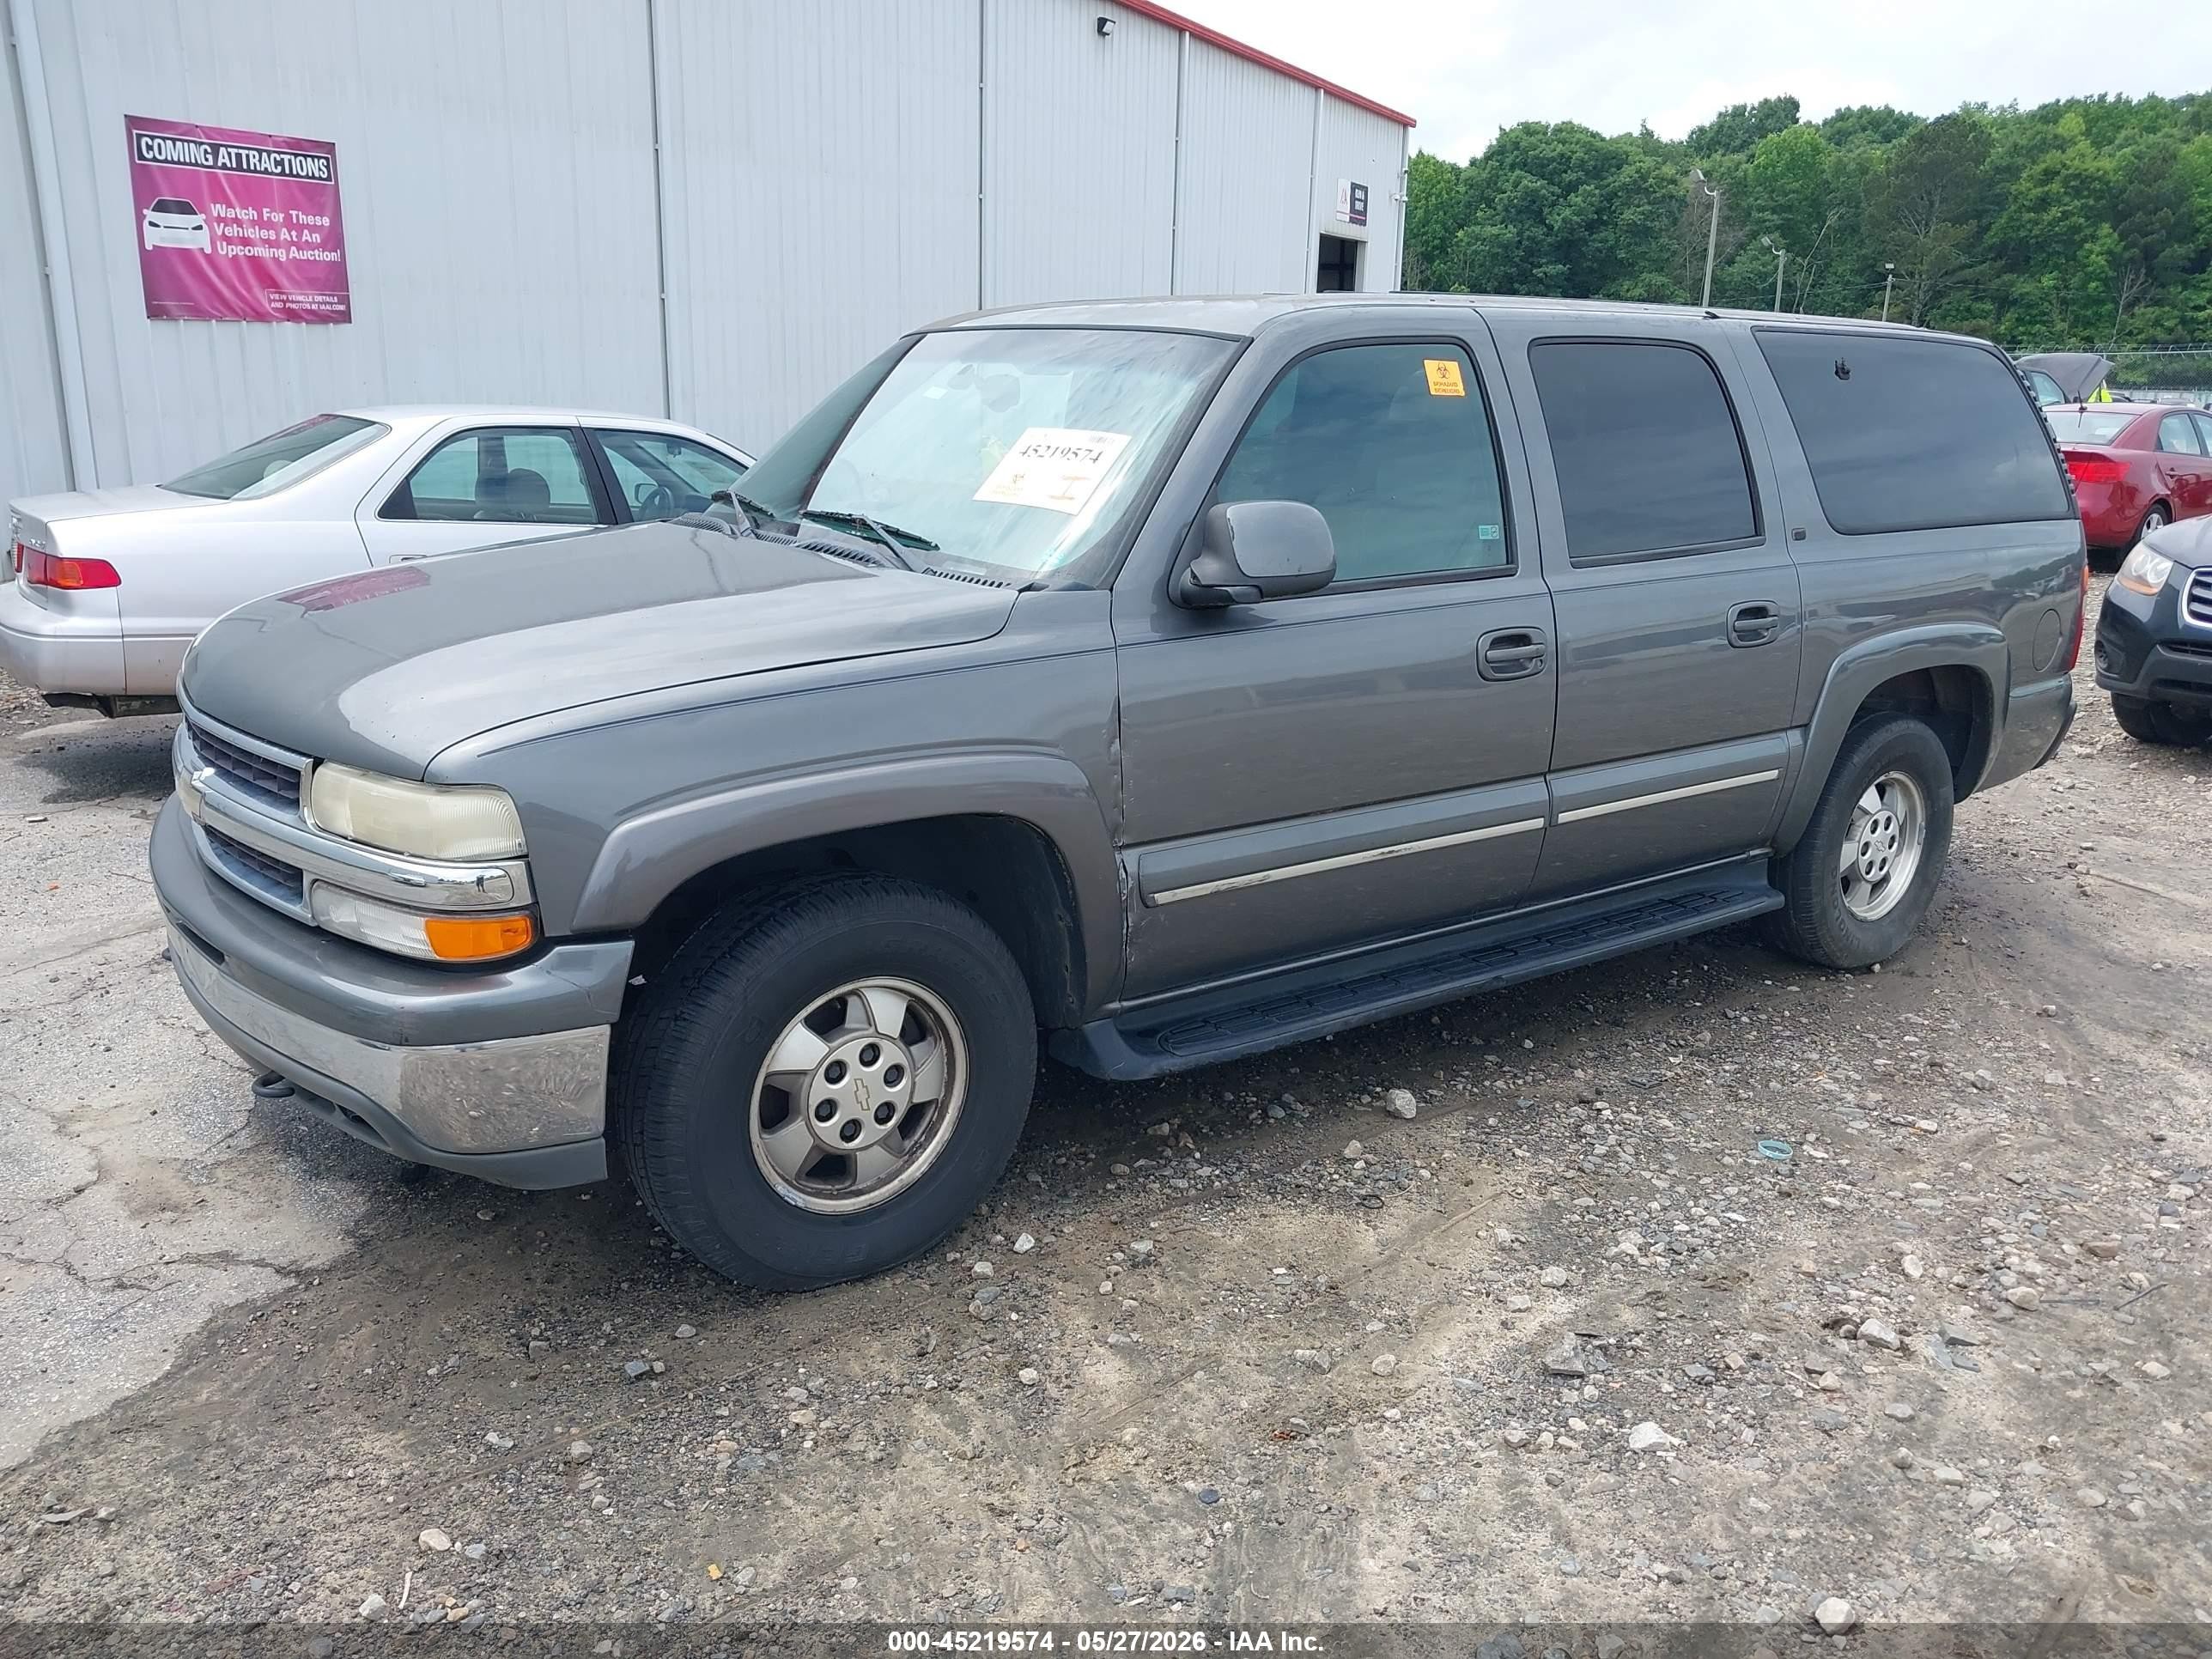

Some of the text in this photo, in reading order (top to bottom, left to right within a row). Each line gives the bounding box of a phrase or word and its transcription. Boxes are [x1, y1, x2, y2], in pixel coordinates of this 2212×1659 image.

[141, 137, 329, 179] COMING ATTRACTIONS
[210, 204, 330, 227] Watch For These
[214, 222, 320, 243] Vehicles At An
[216, 240, 341, 261] Upcoming Auction!
[1019, 444, 1103, 464] 45219574
